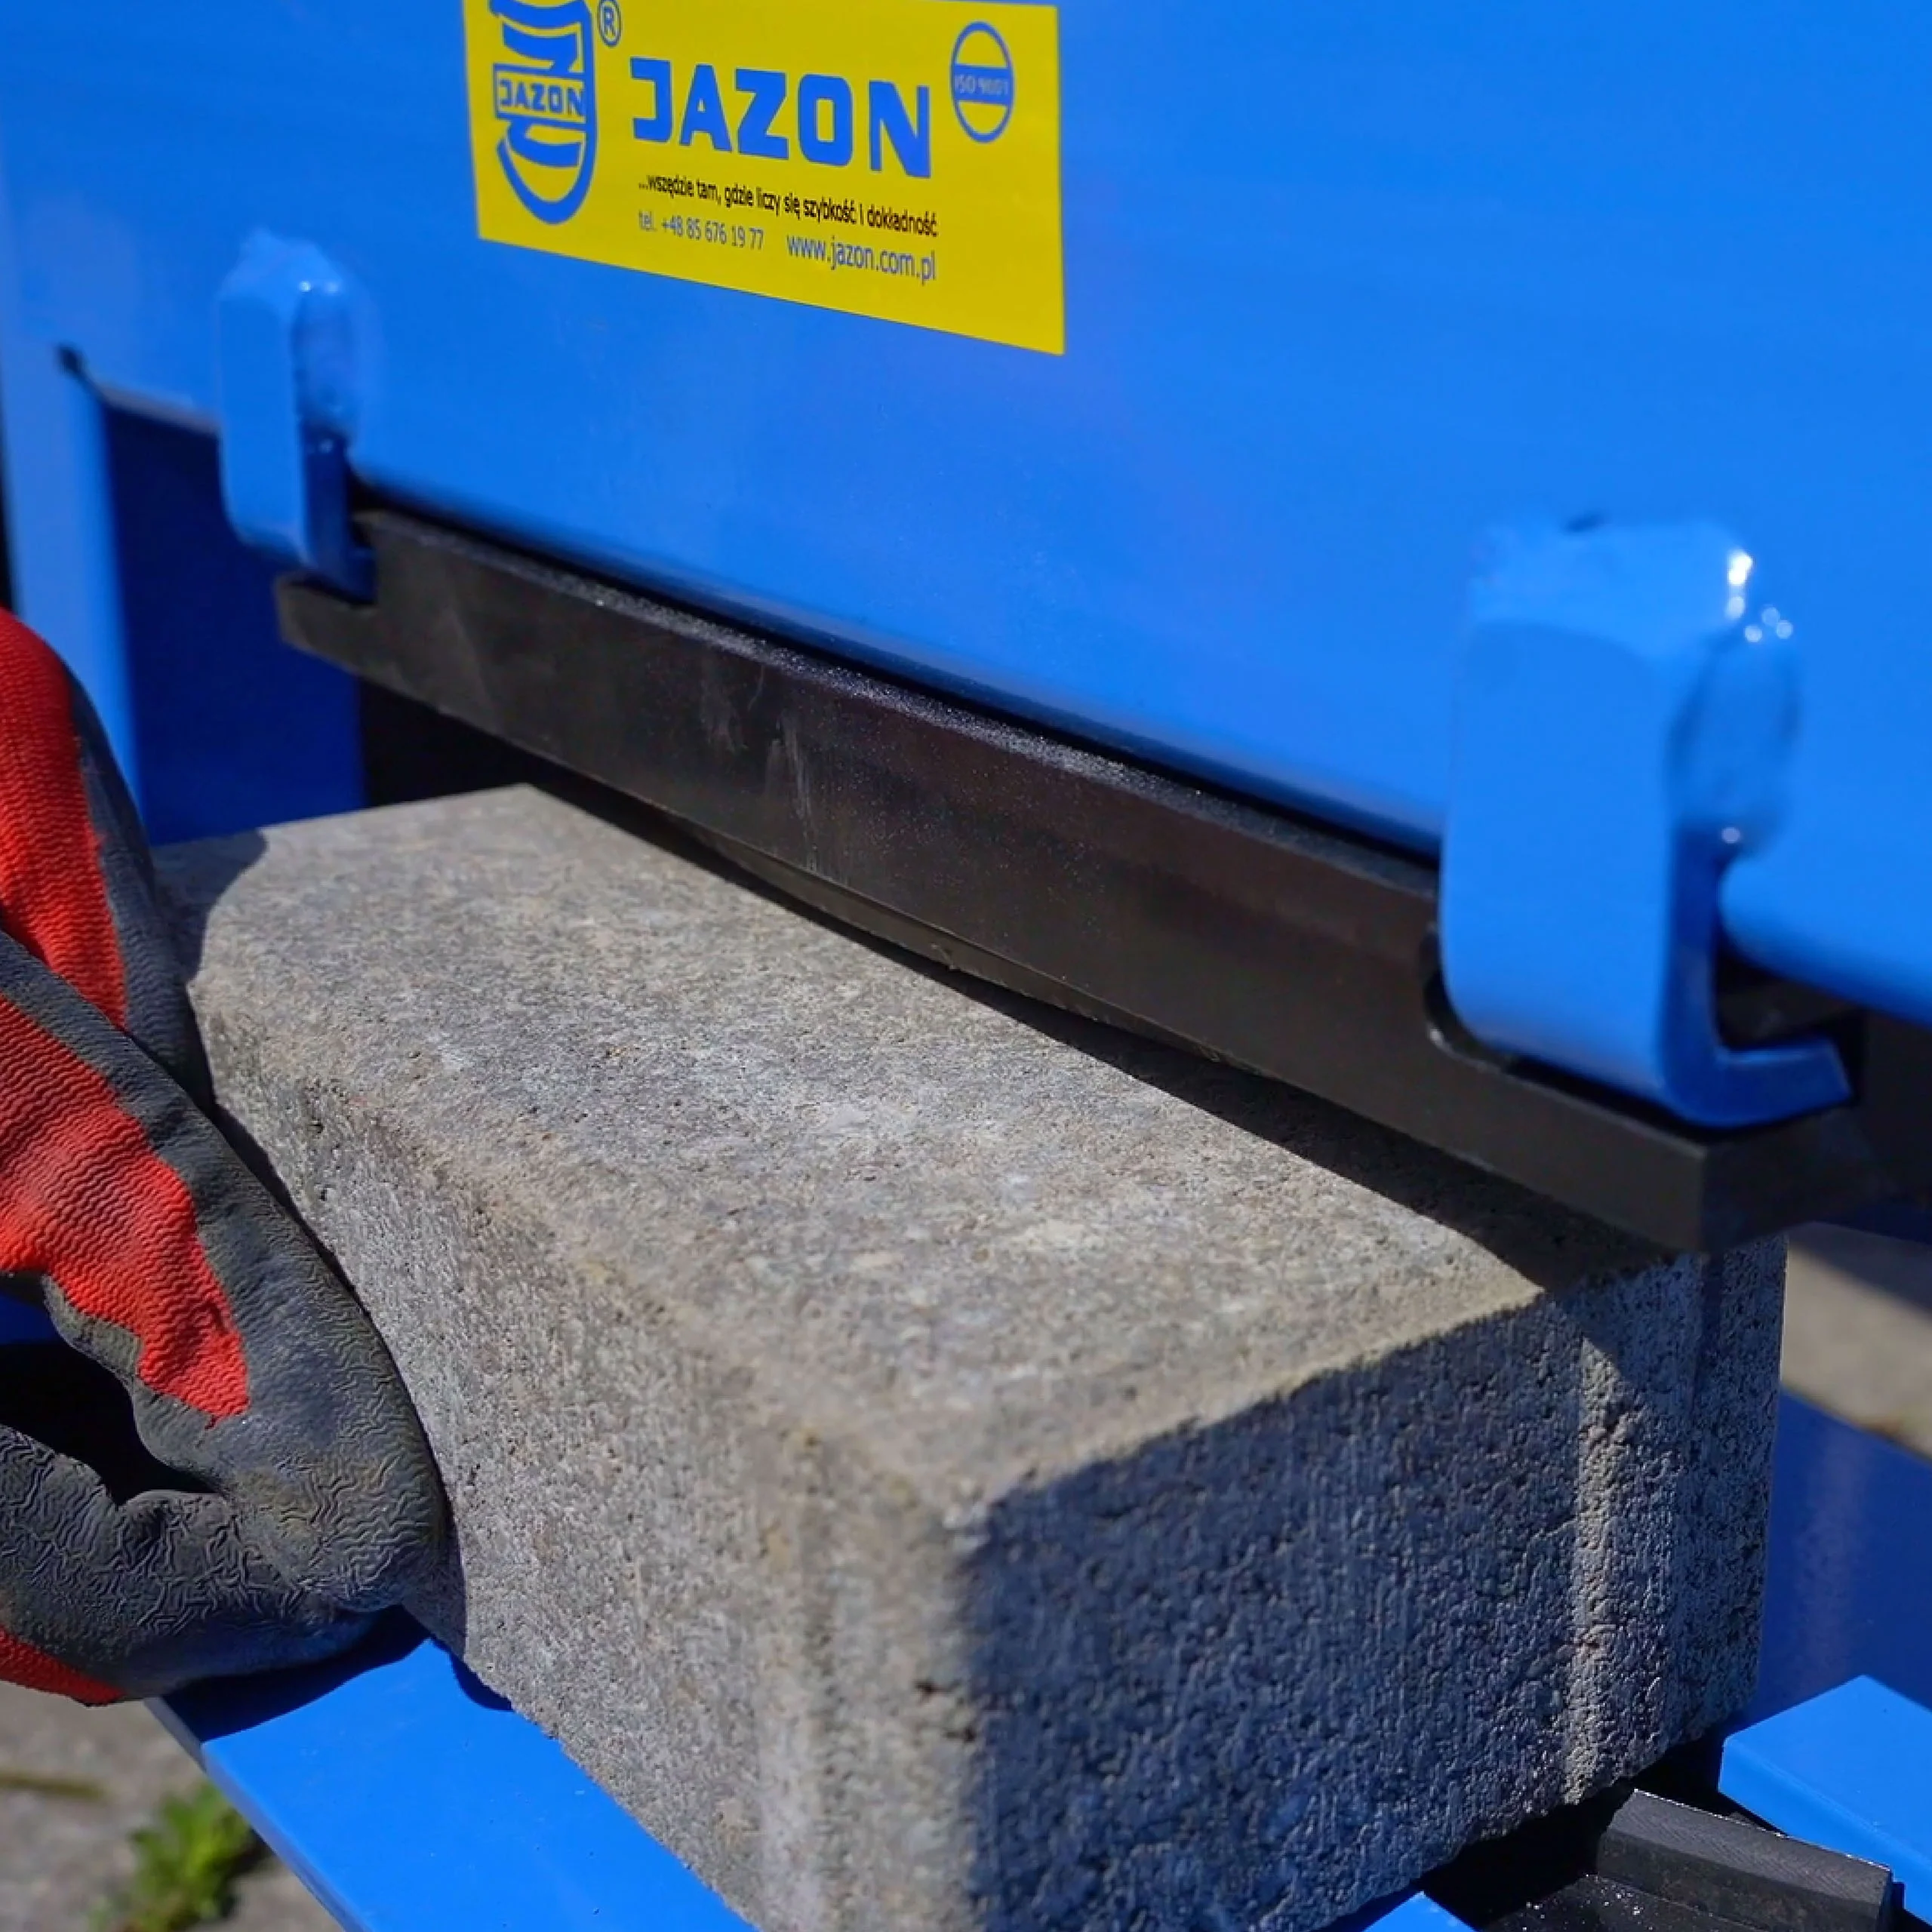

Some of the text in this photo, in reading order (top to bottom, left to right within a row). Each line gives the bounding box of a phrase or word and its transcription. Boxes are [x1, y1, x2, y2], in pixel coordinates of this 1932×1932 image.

[500, 78, 585, 117] JAZON
[629, 57, 932, 179] JAZON
[696, 178, 721, 206] tam,
[724, 182, 753, 208] gdzie
[755, 186, 781, 217] liczy
[783, 192, 801, 220] się
[803, 196, 857, 224] szybkość
[867, 203, 937, 238] dokładność
[638, 210, 937, 287] tel. +48 85 676 19 77 www.jazon.com.pl
